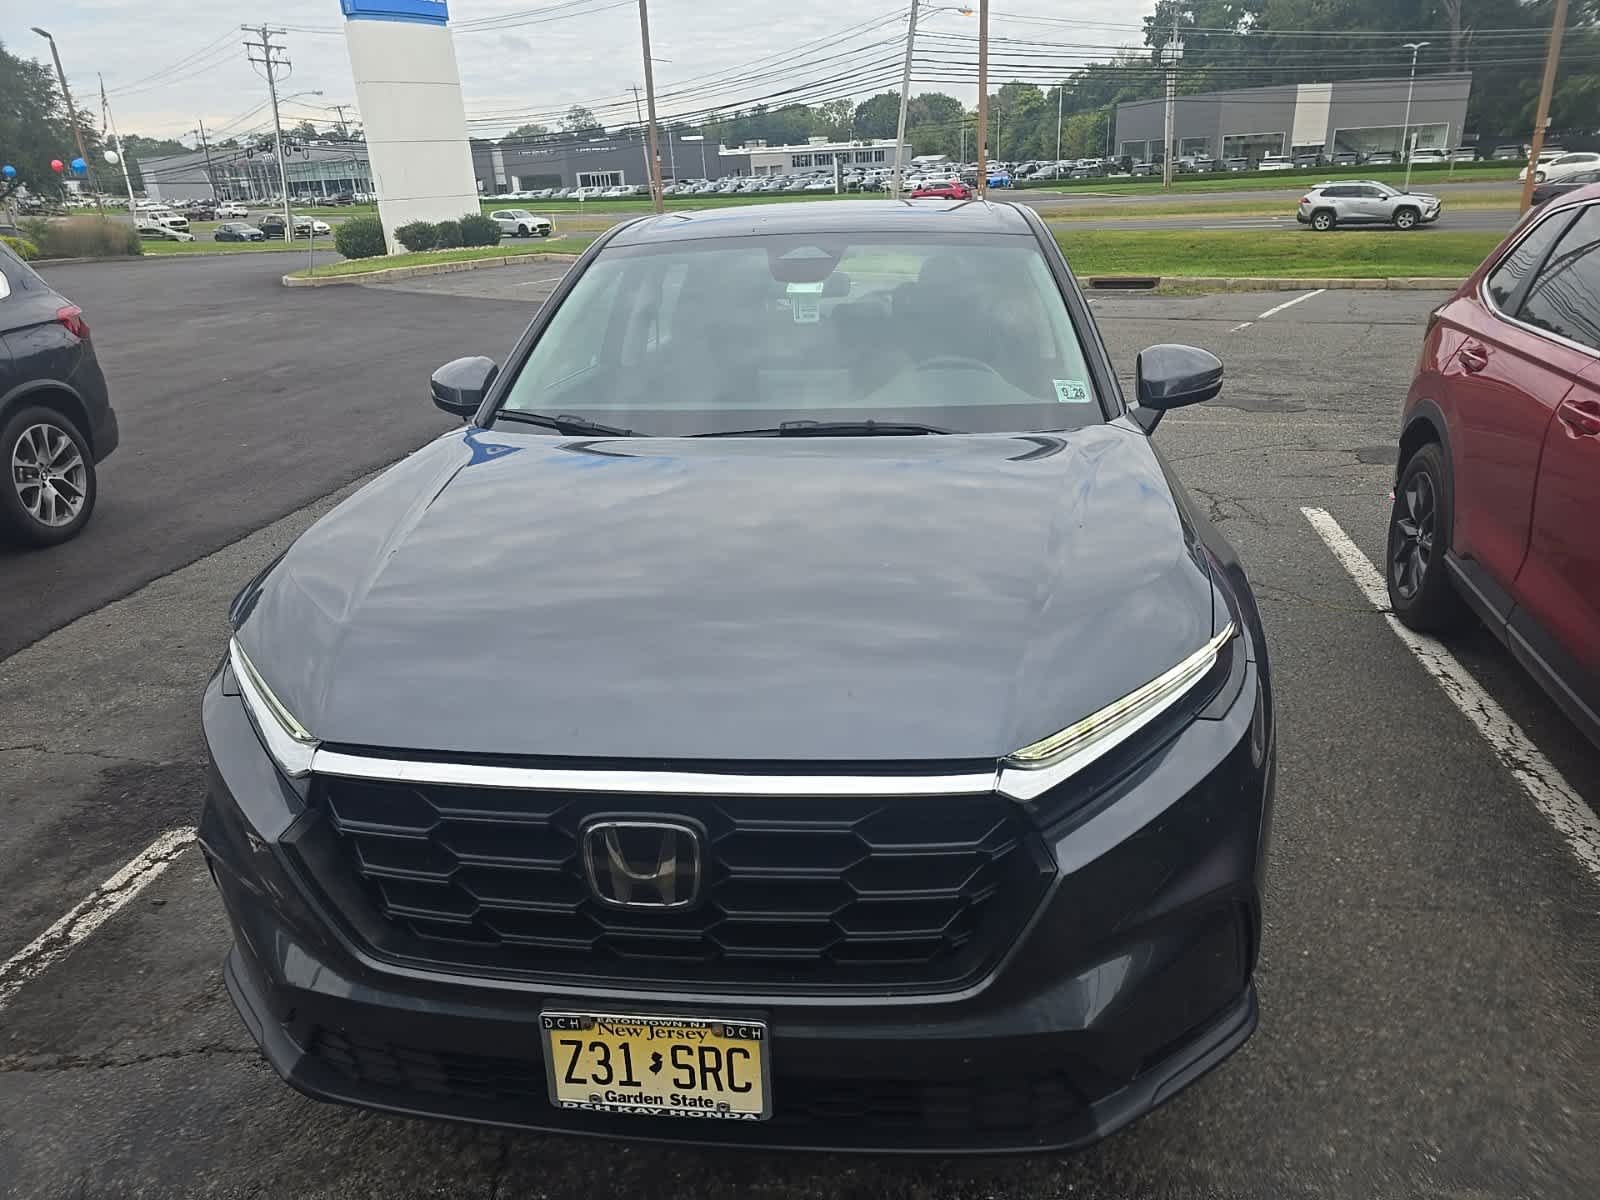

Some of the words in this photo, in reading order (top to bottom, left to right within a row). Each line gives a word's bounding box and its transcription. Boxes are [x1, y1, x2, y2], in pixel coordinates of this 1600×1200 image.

[597, 1023, 642, 1038] New
[646, 1025, 708, 1043] Jersey
[560, 1040, 641, 1087] Z31
[670, 1045, 753, 1093] SRC
[605, 1090, 663, 1105] Garden
[670, 1094, 714, 1109] State
[669, 1109, 759, 1121] HONDA
